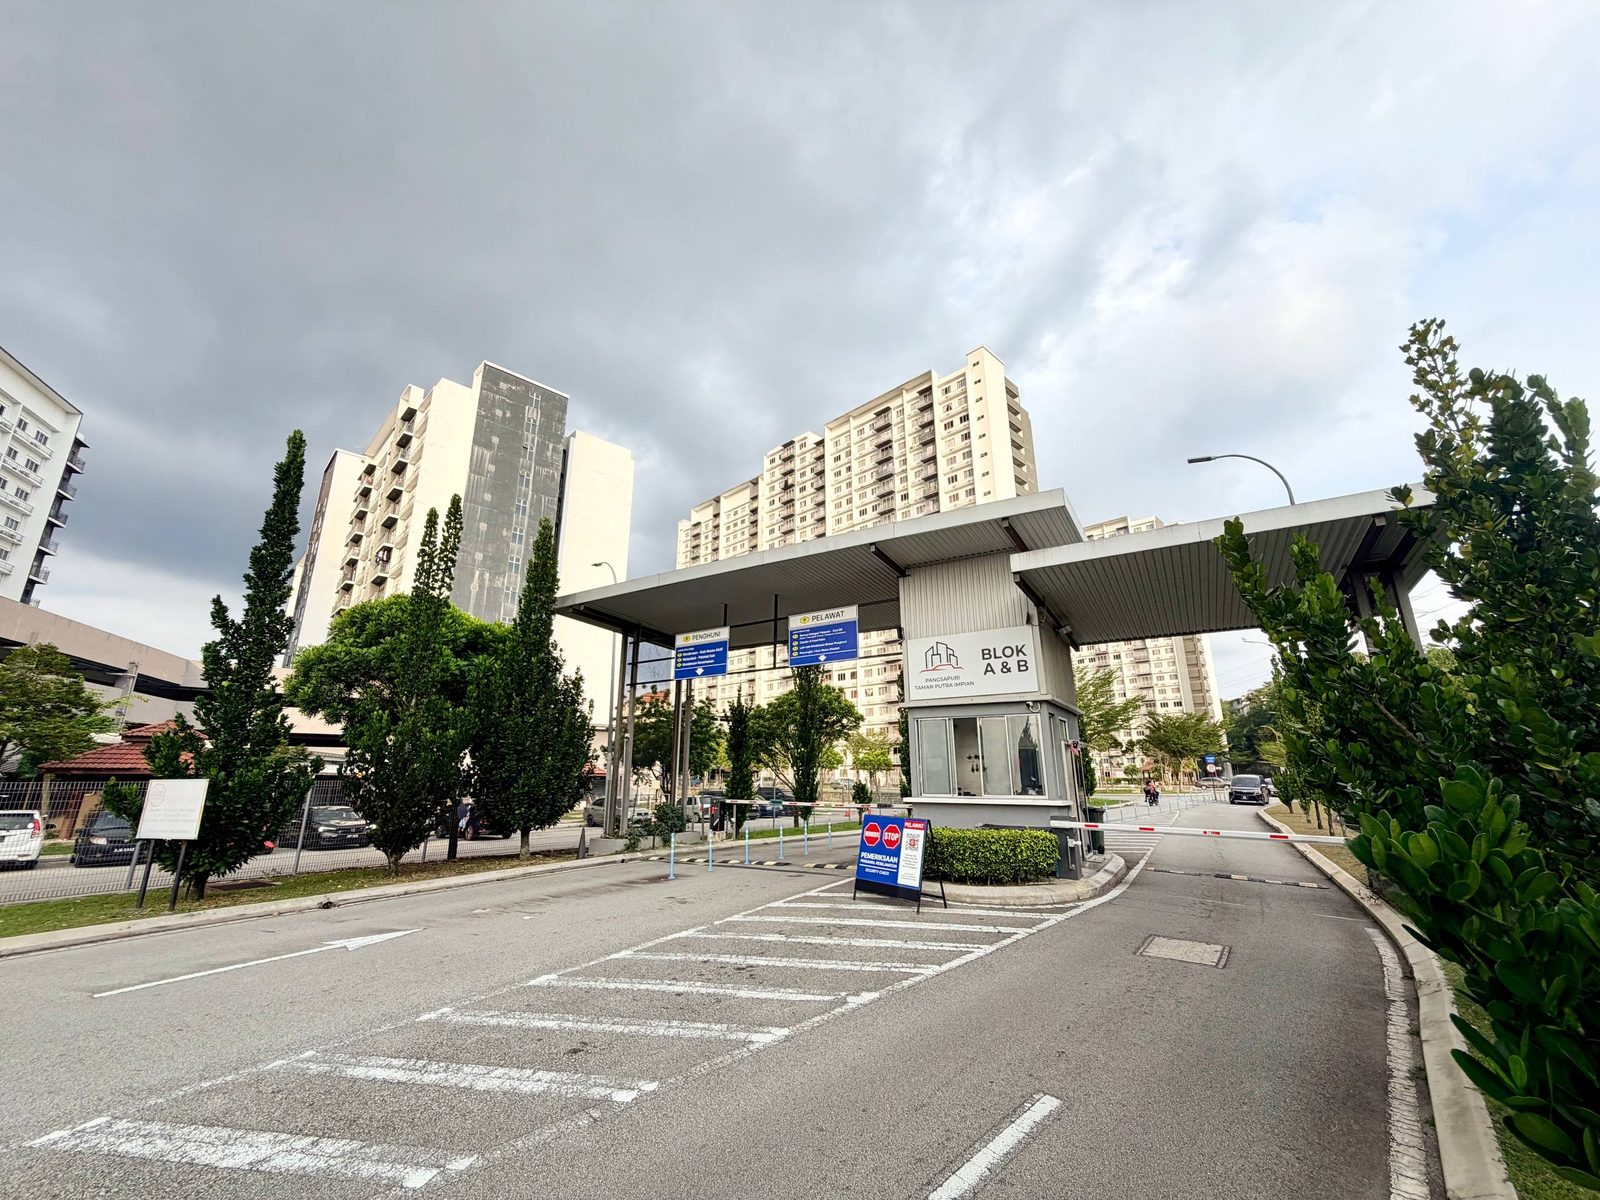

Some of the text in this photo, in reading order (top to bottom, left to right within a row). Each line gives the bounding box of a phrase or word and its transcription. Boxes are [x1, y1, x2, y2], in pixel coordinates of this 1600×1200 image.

[811, 610, 845, 622] PELAWAT
[692, 631, 721, 641] PENGHUNI
[981, 644, 1027, 661] BLOK
[983, 659, 1029, 675] A & B
[925, 675, 961, 683] PANGSAPURI
[934, 682, 953, 690] PUTRA
[884, 832, 899, 841] STOP
[861, 852, 898, 863] PEMERIKSAAN
